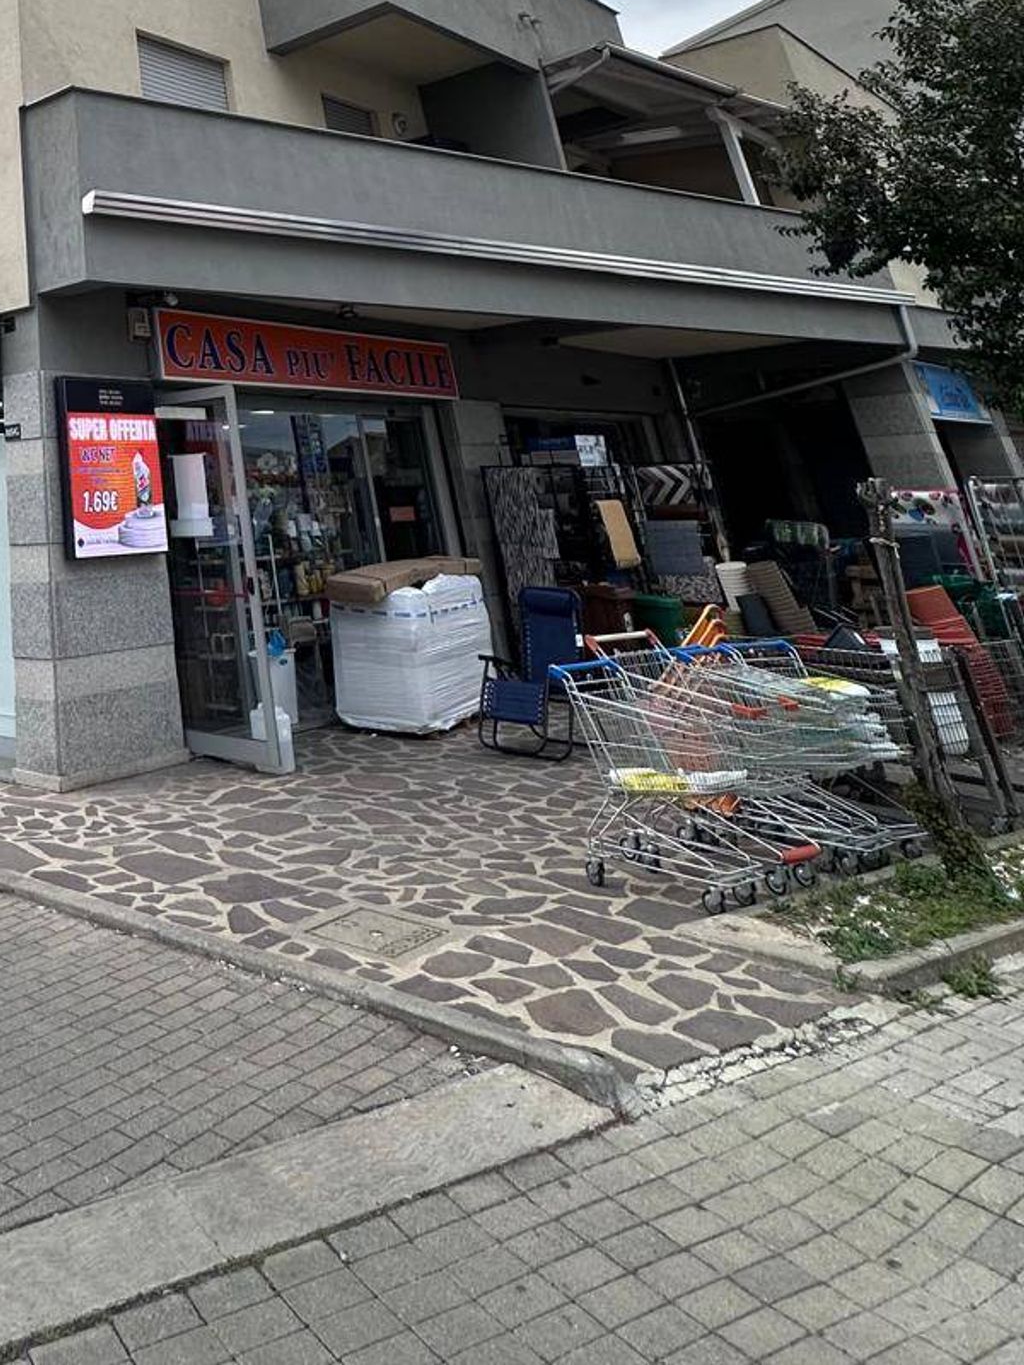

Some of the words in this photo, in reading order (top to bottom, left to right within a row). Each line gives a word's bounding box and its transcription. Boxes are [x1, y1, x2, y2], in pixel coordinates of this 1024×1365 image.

[166, 324, 274, 374] CASA
[344, 344, 452, 389] FACILE
[69, 417, 108, 441] SUPER
[82, 490, 119, 513] 1.69€
